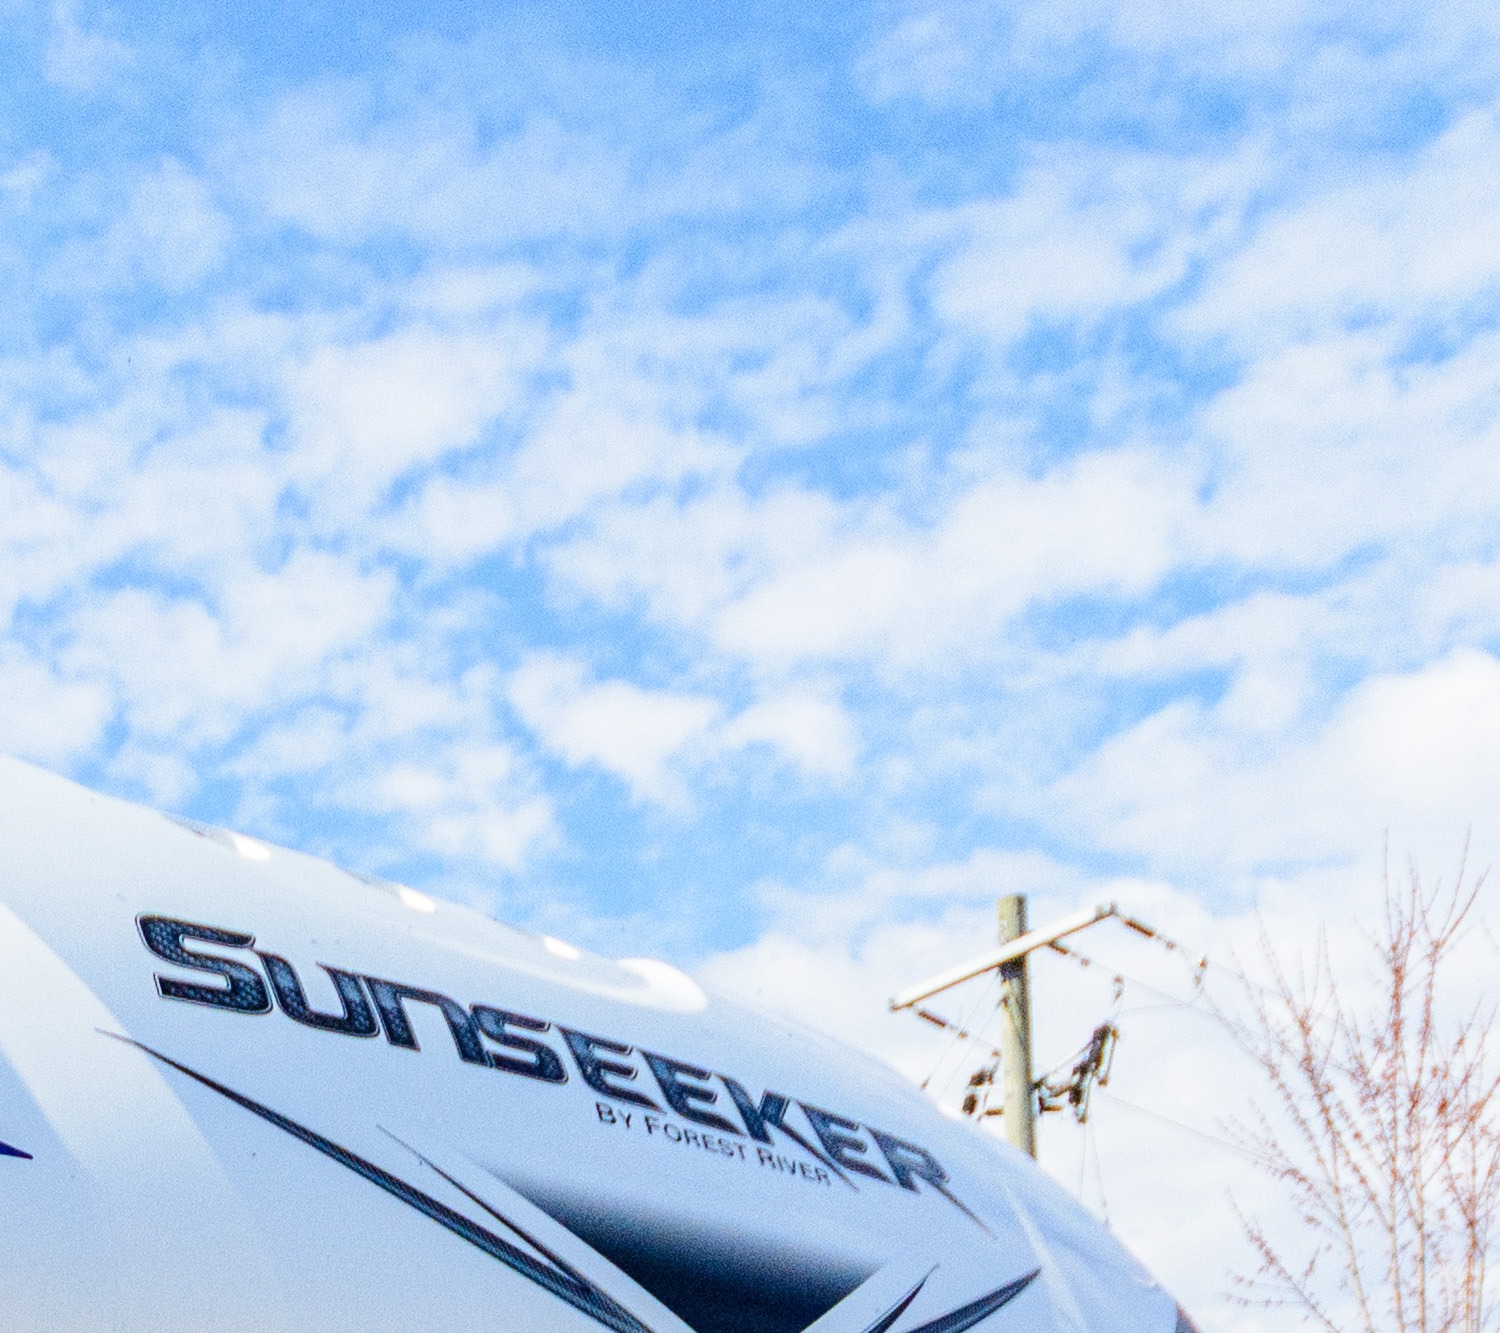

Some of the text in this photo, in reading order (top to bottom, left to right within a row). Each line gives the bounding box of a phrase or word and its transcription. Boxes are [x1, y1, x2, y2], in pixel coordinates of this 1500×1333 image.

[134, 910, 996, 1239] SUNSEEKER
[595, 1100, 831, 1186] BY FOREST RIVER
